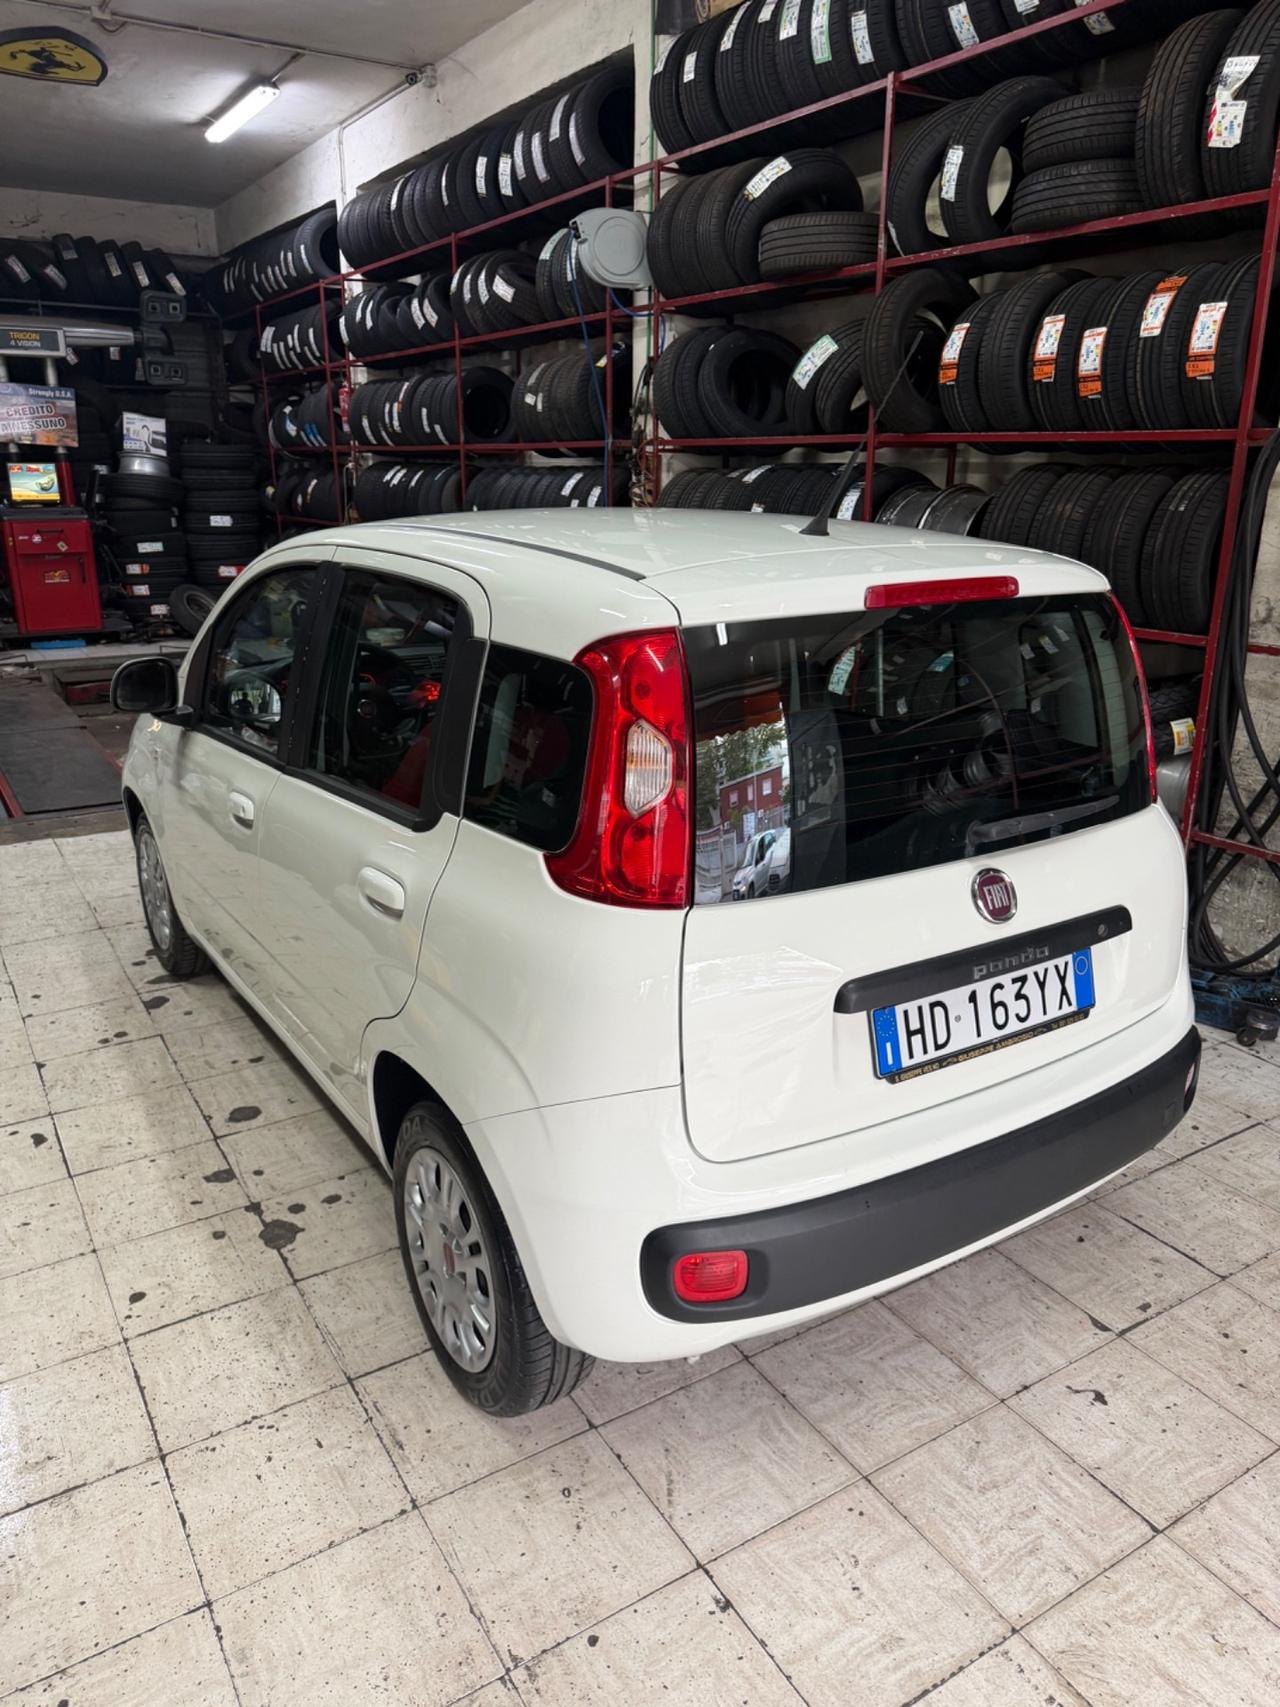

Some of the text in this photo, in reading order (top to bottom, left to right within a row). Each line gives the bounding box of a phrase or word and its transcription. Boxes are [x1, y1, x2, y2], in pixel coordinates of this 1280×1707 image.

[6, 404, 54, 417] CREDITO
[983, 882, 1010, 910] FIAT
[974, 946, 1049, 980] panda
